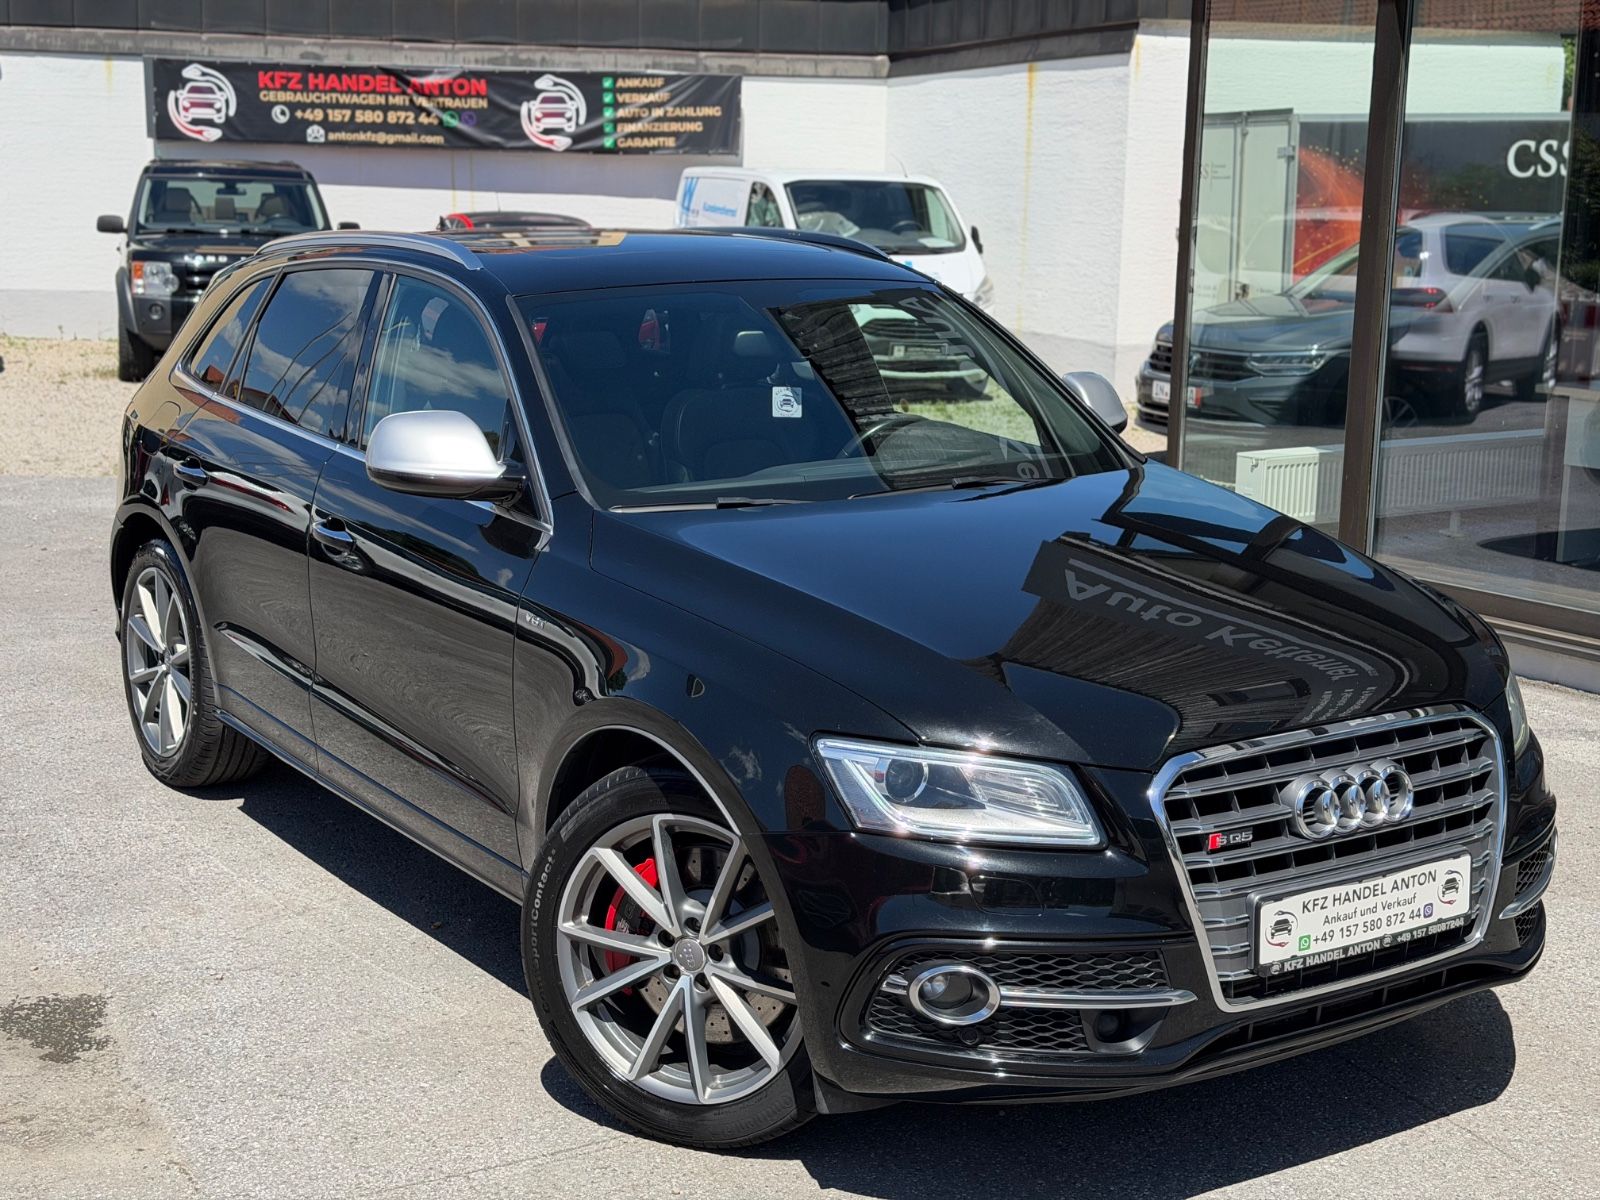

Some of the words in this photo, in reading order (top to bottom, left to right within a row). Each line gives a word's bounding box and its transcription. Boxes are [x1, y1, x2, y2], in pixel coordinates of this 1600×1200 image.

[258, 71, 303, 90] KFZ
[308, 73, 402, 93] HANDEL
[407, 76, 488, 96] ANTON
[616, 77, 665, 88] ANKAUF
[259, 90, 386, 106] GEBRAUCHTWAGEN
[388, 94, 411, 106] MIT
[616, 92, 671, 103] VERKAUF
[294, 107, 324, 122] +49
[325, 108, 352, 123] 157
[354, 109, 384, 124] 580
[387, 110, 416, 125] 872
[418, 111, 439, 126] 44
[616, 107, 649, 118] AUTO
[651, 107, 665, 117] IN
[666, 106, 722, 117] ZAHLUNG
[617, 122, 703, 132] FINANZIERUNG
[327, 130, 445, 145] antonkfz@gmail.com
[617, 137, 676, 148] GARANTIE
[1302, 896, 1329, 914] KFZ
[1332, 882, 1387, 907] HANDEL
[1391, 869, 1437, 893] ANTON
[1323, 907, 1357, 926] Ankauf
[1360, 902, 1378, 917] und
[1381, 893, 1417, 911] Verkauf
[1313, 930, 1335, 945] +49
[1339, 923, 1359, 939] 157
[1362, 917, 1382, 933] 580
[1386, 911, 1406, 927] 872
[1409, 907, 1422, 920] 44
[1397, 932, 1411, 944] +49
[1412, 927, 1427, 939] 157
[1428, 918, 1465, 934] 58087244
[1283, 959, 1304, 972] KFZ
[1306, 948, 1346, 967] HANDEL
[1347, 940, 1381, 957] ANTON
